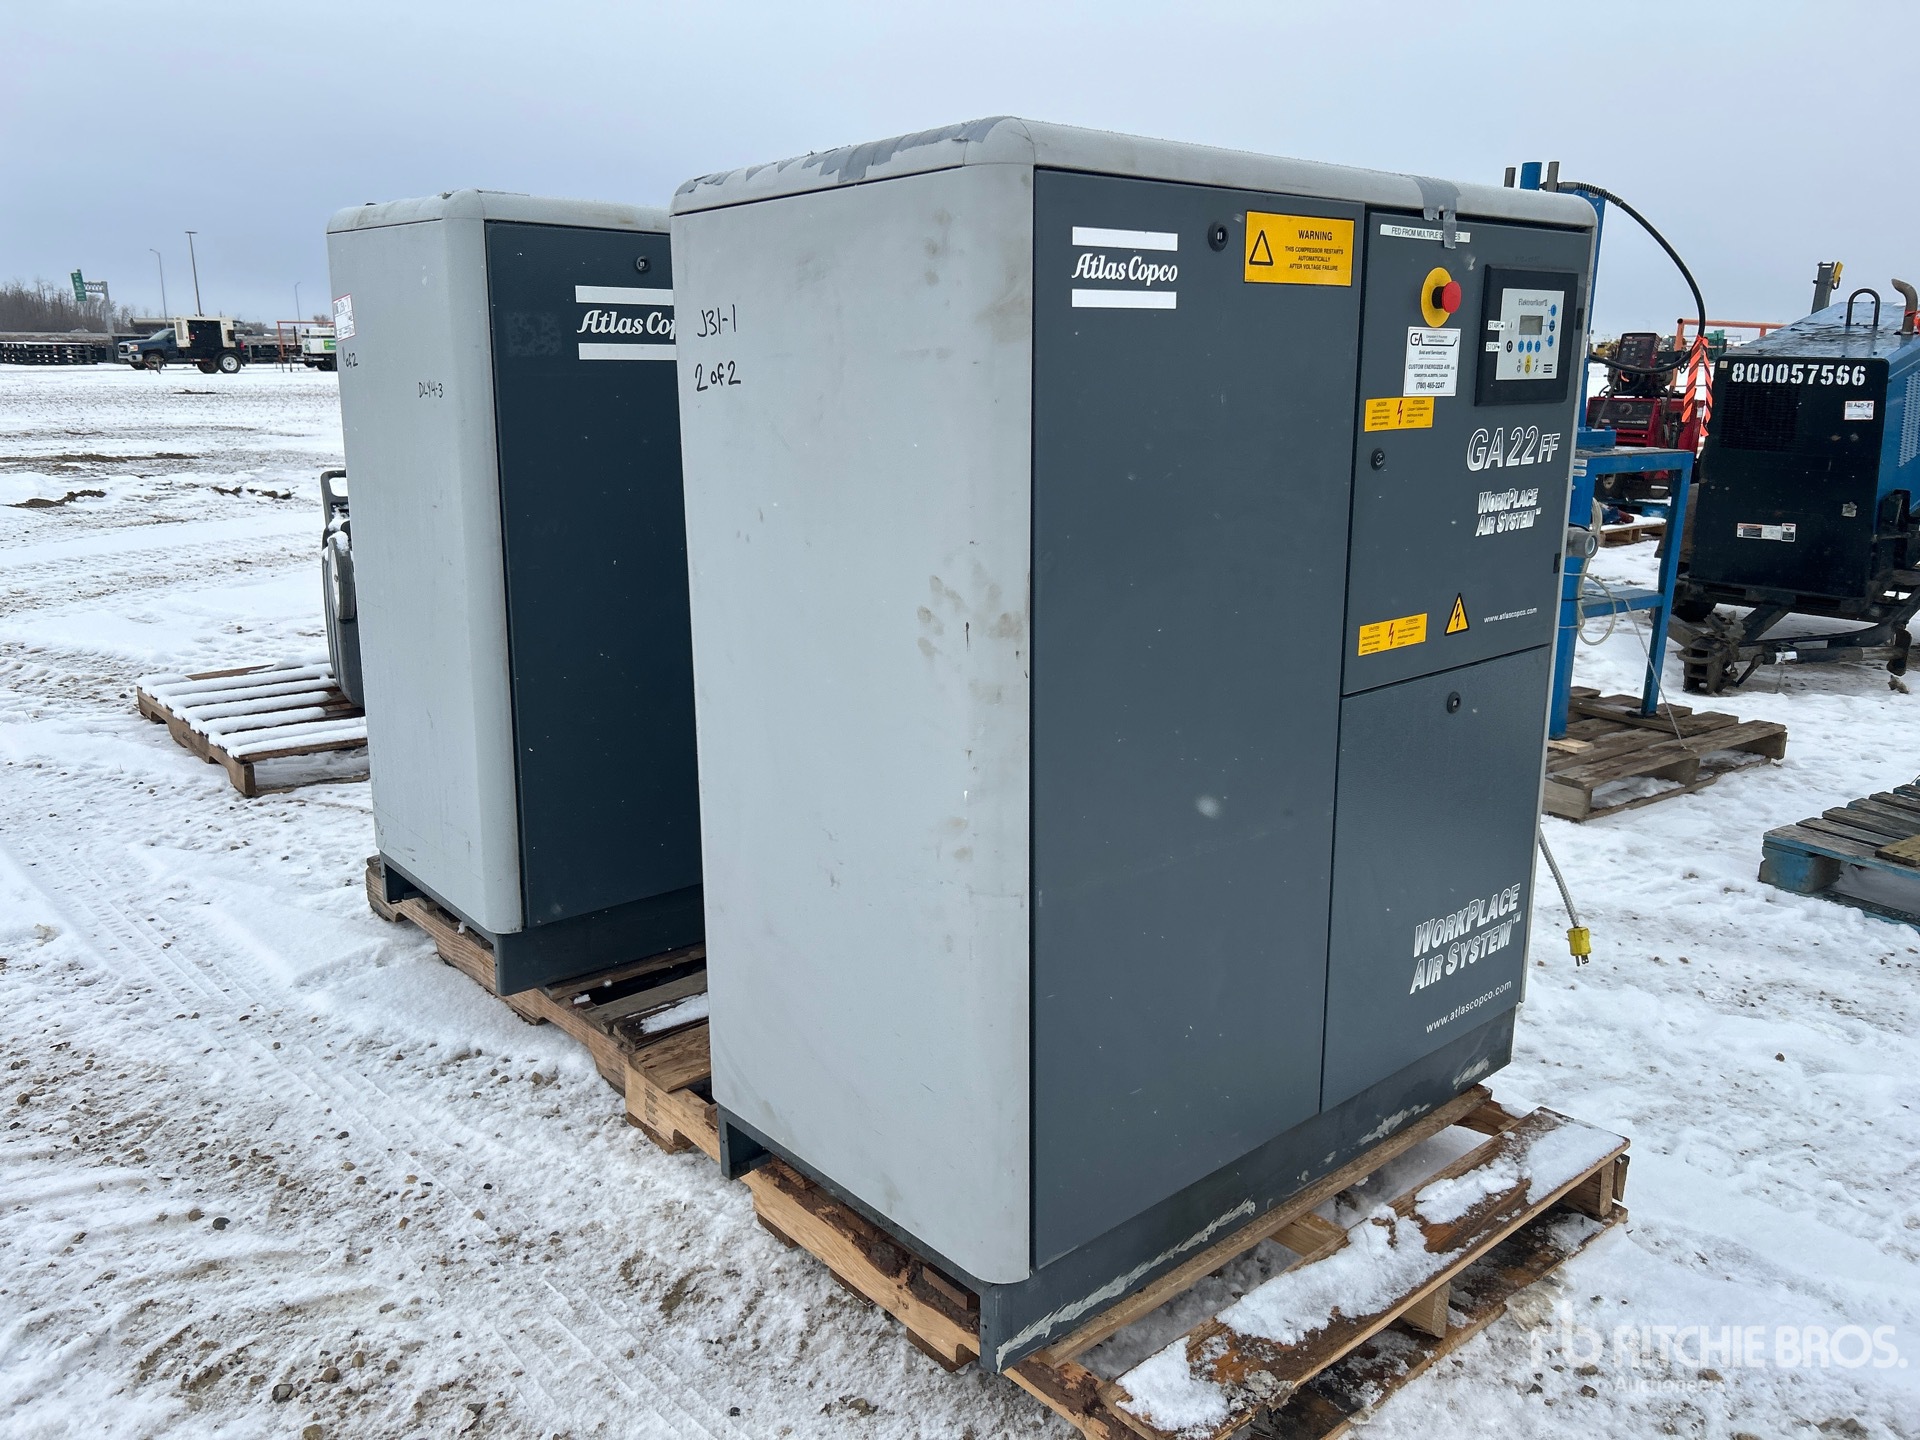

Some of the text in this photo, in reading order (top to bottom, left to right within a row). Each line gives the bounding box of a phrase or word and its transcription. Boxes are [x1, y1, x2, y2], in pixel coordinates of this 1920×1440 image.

[1298, 230, 1333, 241] WARNING
[1295, 246, 1323, 254] COMPRESSOR
[1071, 253, 1178, 286] Atlas Copco
[576, 309, 644, 334] Atlas
[1486, 343, 1498, 351] STOP
[694, 360, 742, 392] 2 of 2
[1731, 362, 1866, 386] 800057566
[1466, 425, 1560, 472] GA 22 FF
[1475, 514, 1496, 536] AIR
[1484, 608, 1538, 623] www.atlascopco.com
[1409, 954, 1444, 994] AIR
[1426, 980, 1512, 1034] www.atlascopco.com
